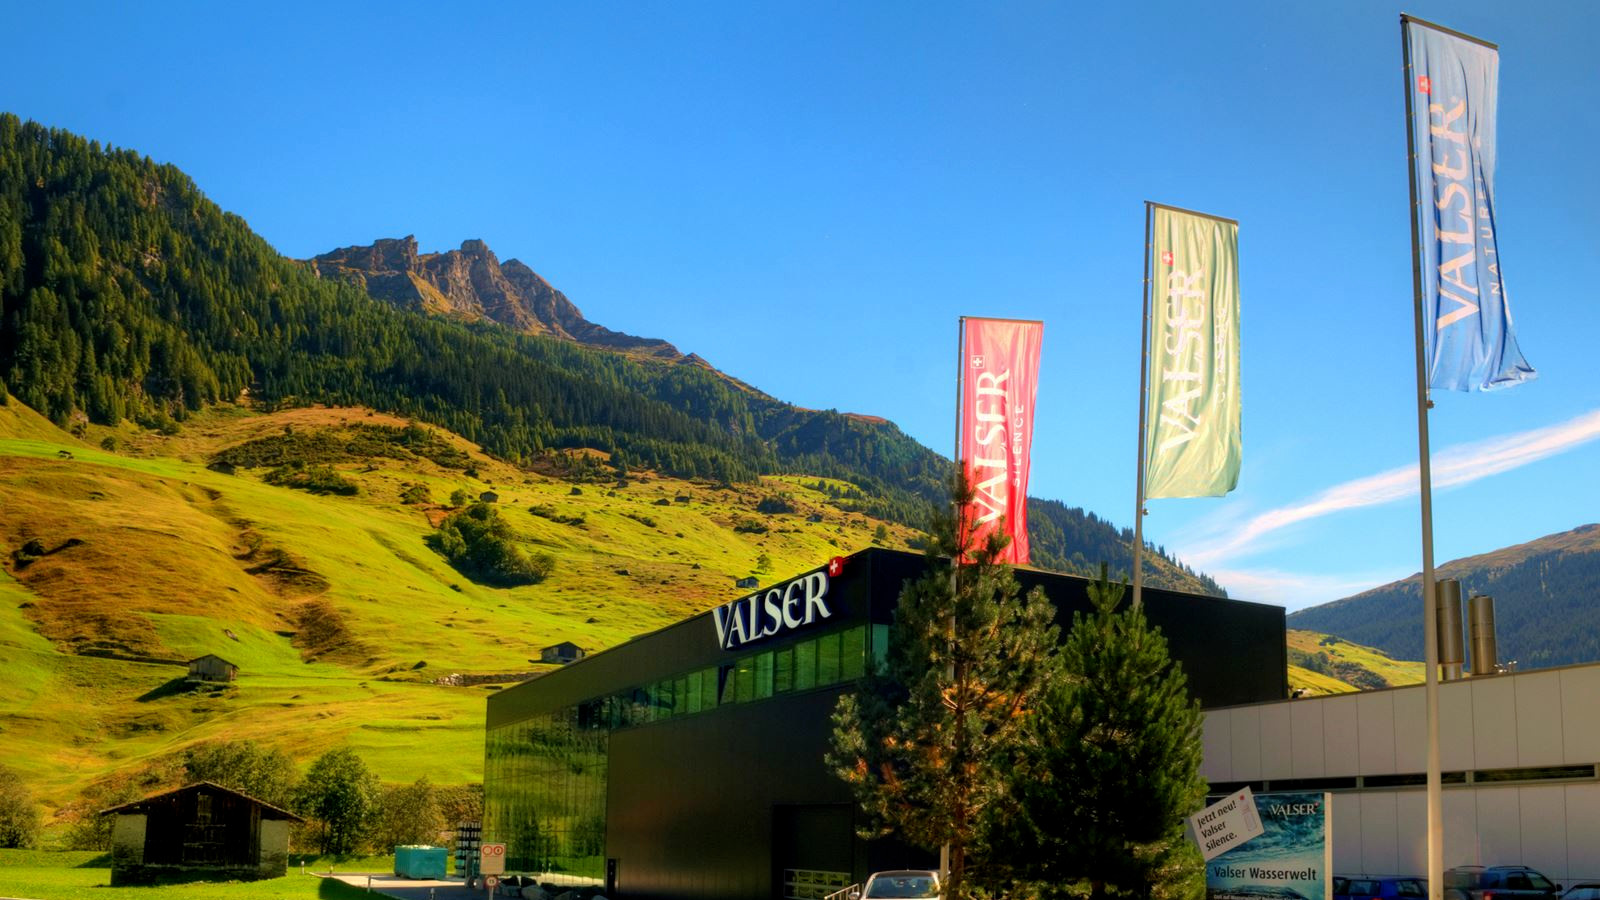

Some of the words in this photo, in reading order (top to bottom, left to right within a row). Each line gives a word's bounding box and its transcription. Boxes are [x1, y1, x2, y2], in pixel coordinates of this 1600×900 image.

[1429, 98, 1480, 332] VALSER
[1474, 135, 1501, 296] NATURE
[1159, 264, 1206, 454] VALSER
[974, 368, 1010, 524] VALSER
[1013, 404, 1024, 488] SILENCE
[712, 571, 832, 649] VALSER
[1197, 811, 1216, 829] Jetzt
[1217, 800, 1237, 817] neu!
[1201, 820, 1227, 839] Valser
[1206, 831, 1238, 852] Silence.
[1270, 804, 1316, 820] VALSER
[1214, 865, 1246, 879] Valser
[1249, 867, 1317, 881] Wasserwelt
